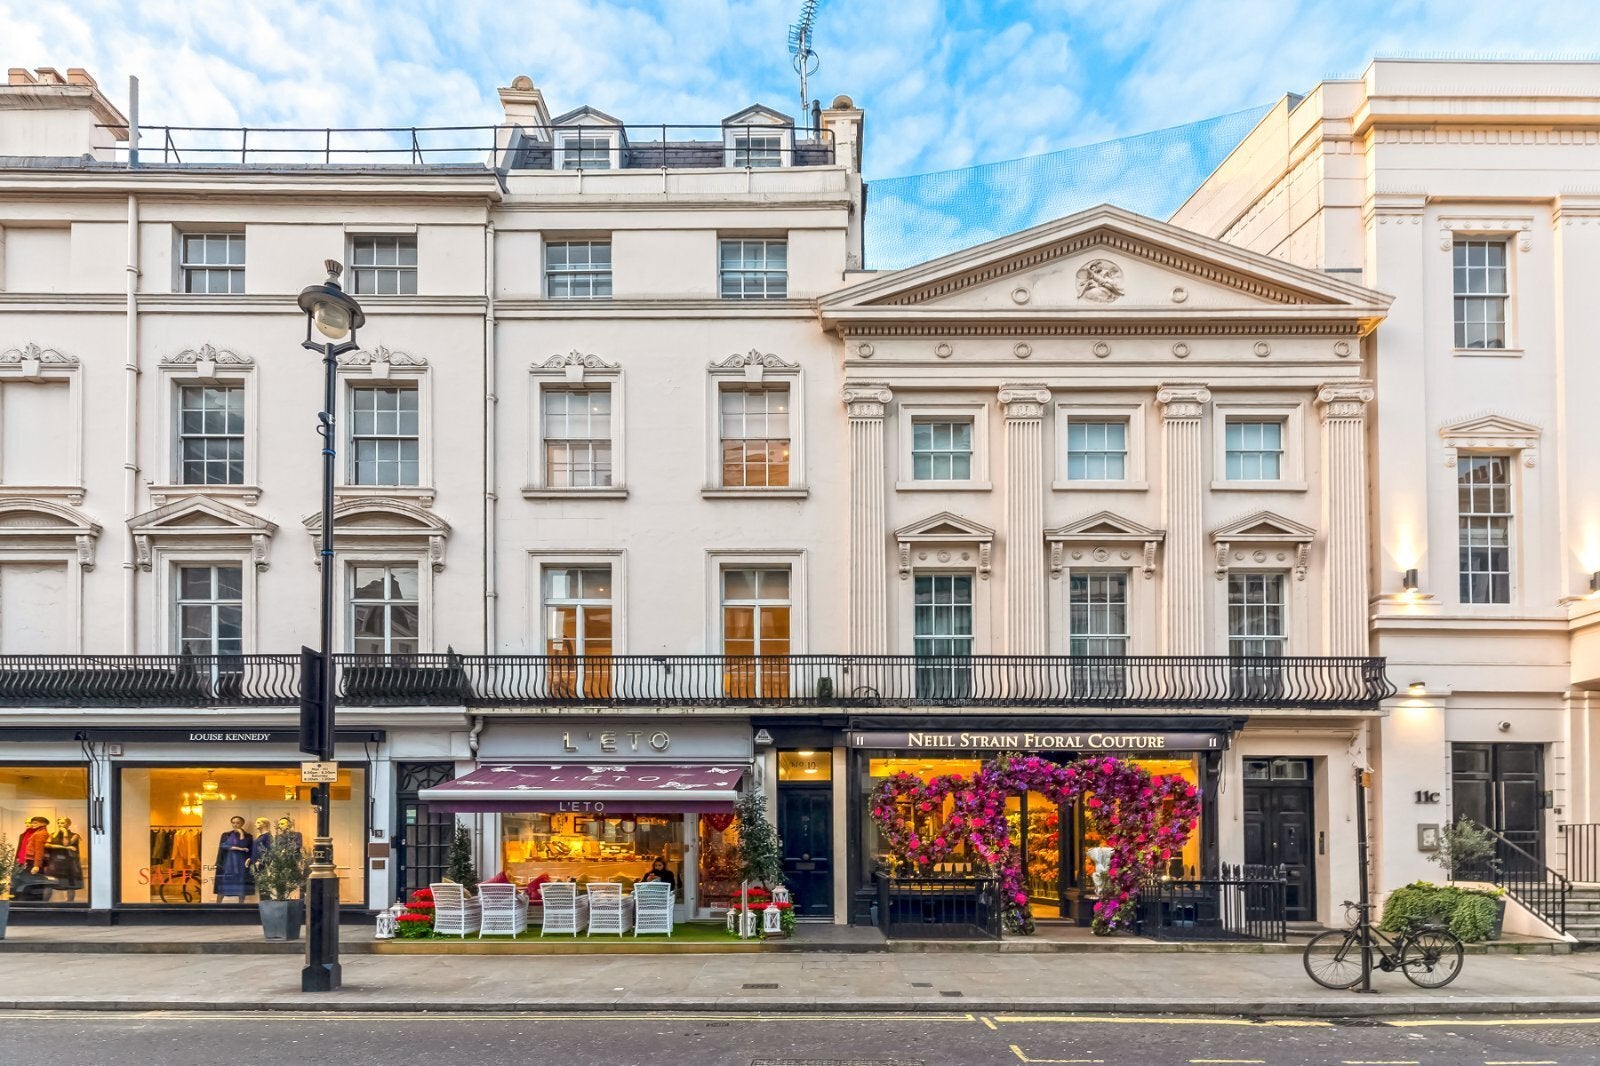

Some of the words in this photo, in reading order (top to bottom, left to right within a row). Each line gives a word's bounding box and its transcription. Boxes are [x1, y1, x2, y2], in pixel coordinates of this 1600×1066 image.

[189, 733, 224, 741] LOUISE
[225, 733, 271, 741] KENNEDY
[563, 730, 670, 752] L'ETO
[907, 732, 956, 747] NEILL
[959, 732, 1018, 748] STRAIN
[1023, 733, 1083, 748] FLORAL
[1087, 733, 1165, 748] COUTURE
[559, 801, 604, 812] L'ETO
